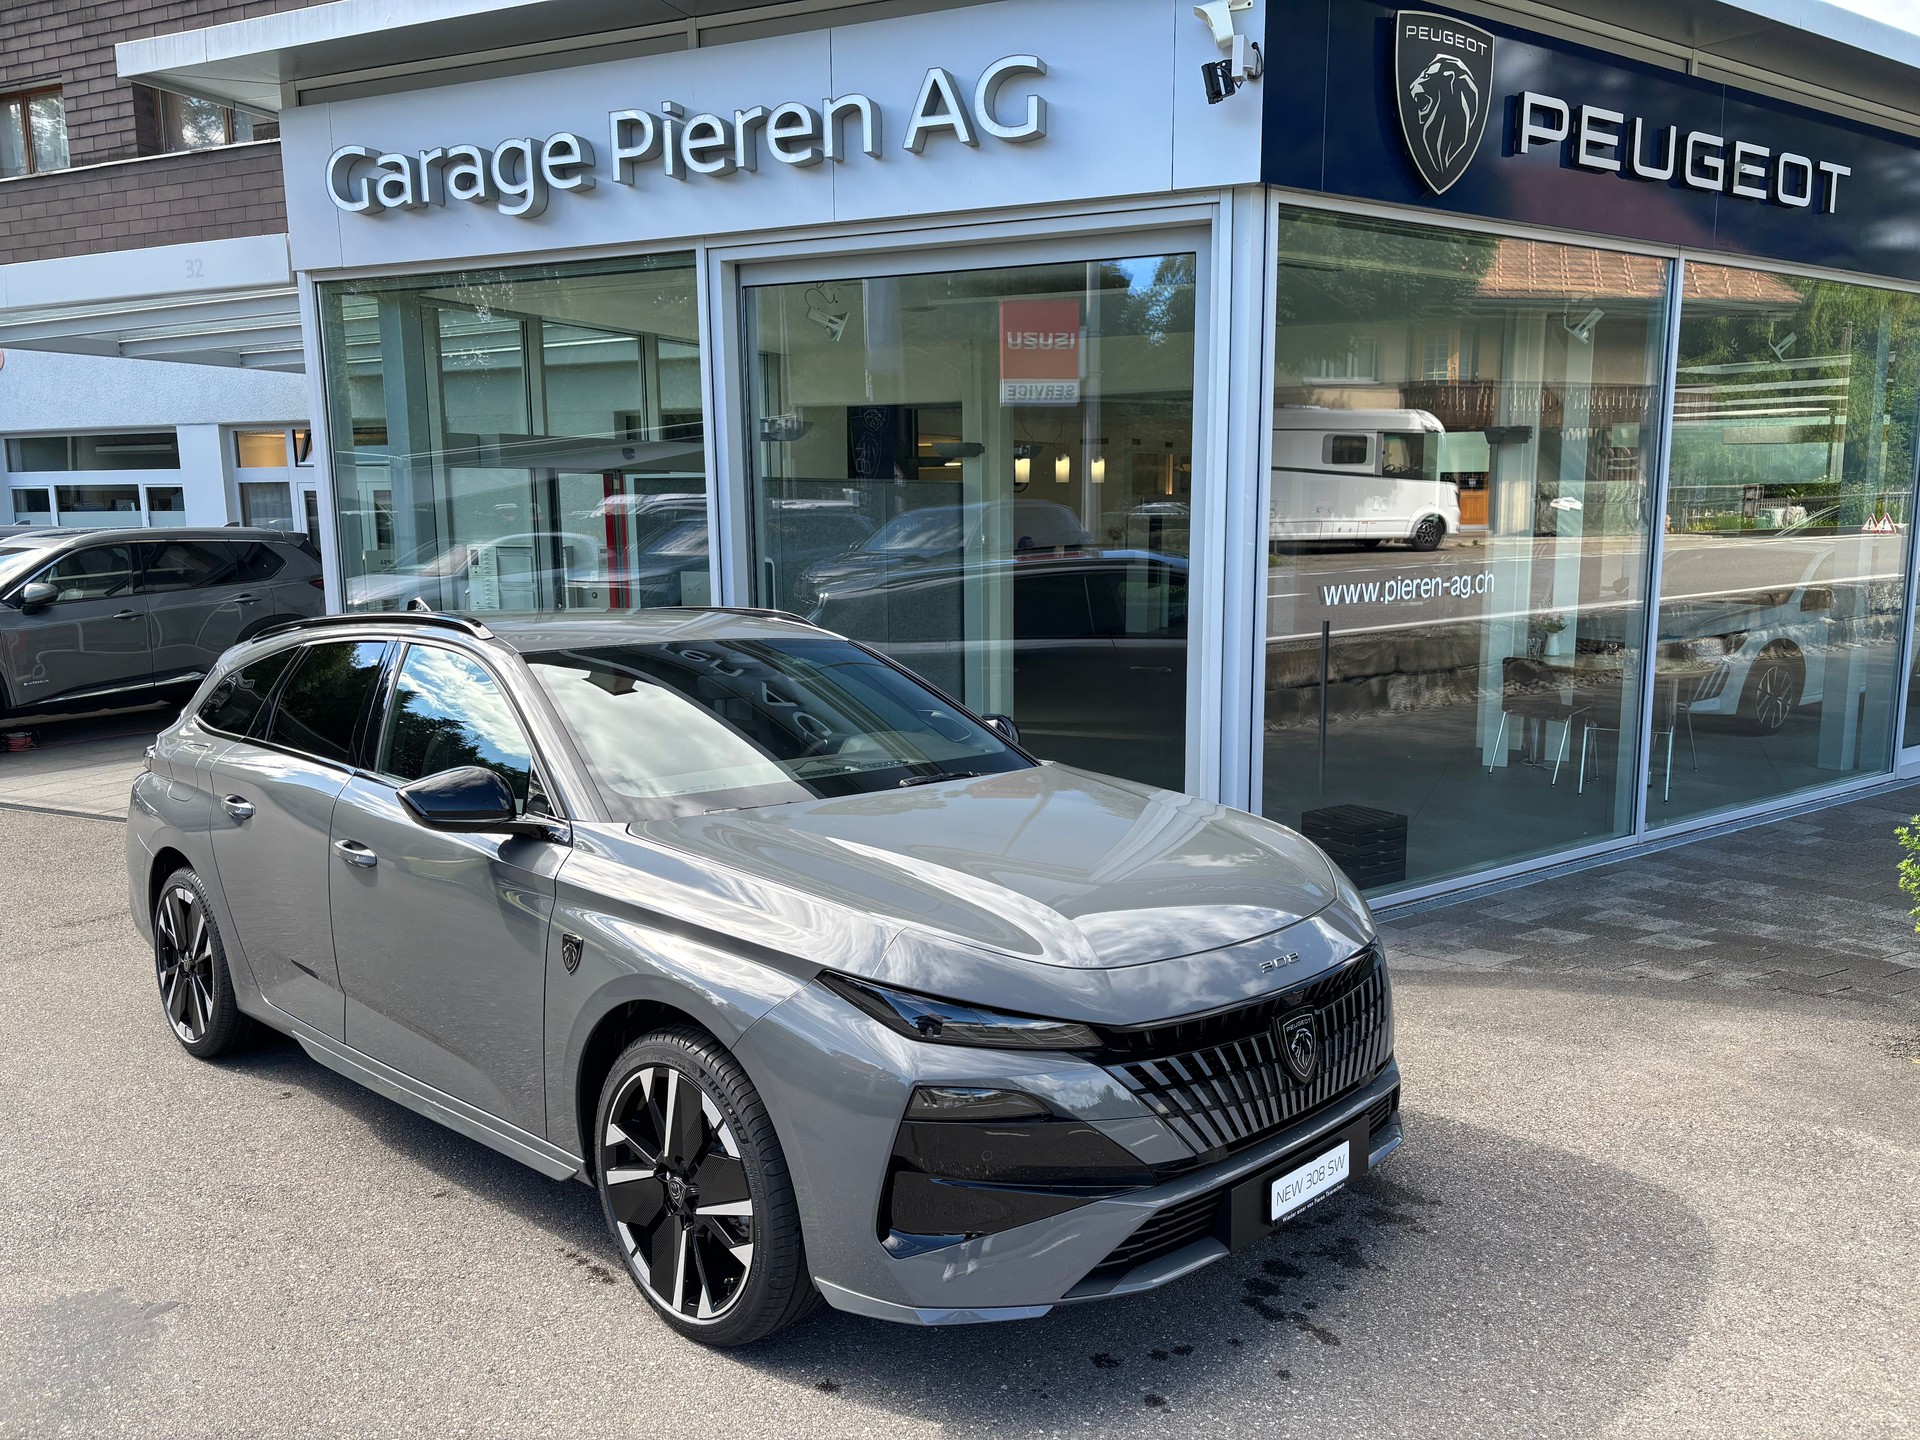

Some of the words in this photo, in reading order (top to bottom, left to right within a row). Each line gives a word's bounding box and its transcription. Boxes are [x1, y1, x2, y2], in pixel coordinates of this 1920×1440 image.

[1406, 25, 1488, 56] PEUGEOT
[325, 131, 596, 218] Garage
[608, 93, 882, 185] Pieren
[902, 54, 1047, 154] AG
[1519, 90, 1852, 214] PEUGEOT
[184, 258, 205, 279] 32
[1323, 570, 1495, 606] www.pieren-ag.ch
[1260, 951, 1300, 974] 308
[1286, 1018, 1311, 1033] PEUGEOT
[1276, 1177, 1304, 1207] NEW
[1305, 1165, 1326, 1190] 308
[1327, 1153, 1346, 1177] SW
